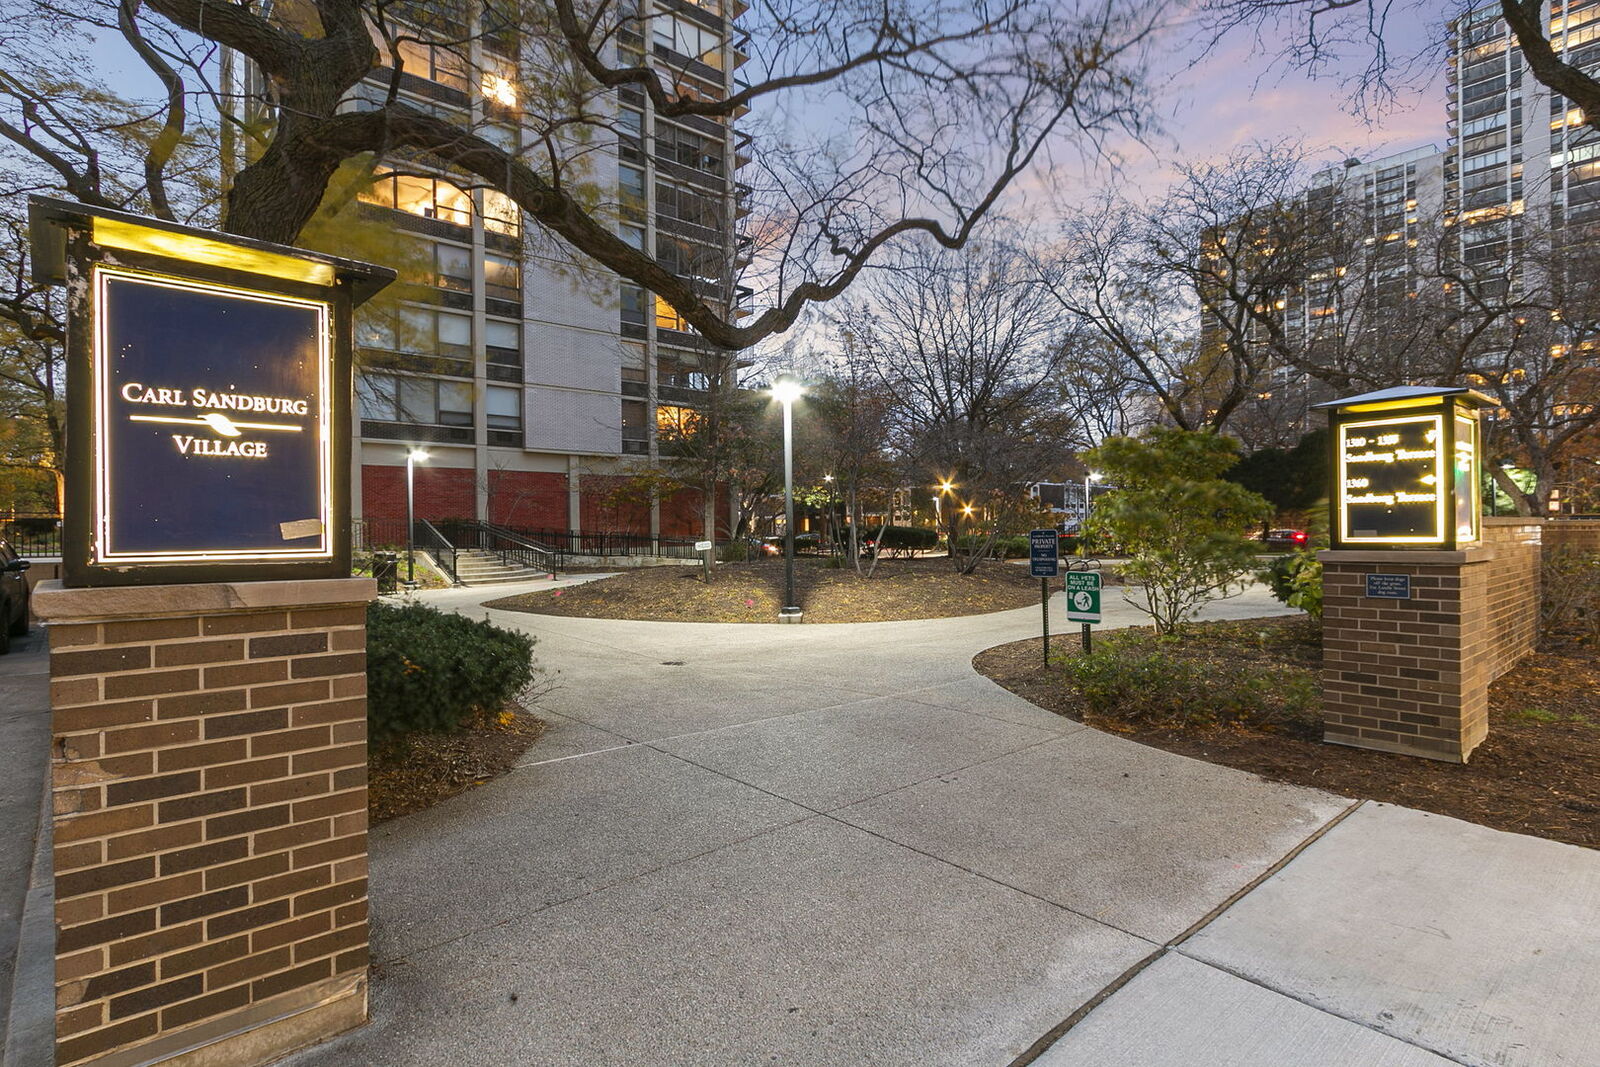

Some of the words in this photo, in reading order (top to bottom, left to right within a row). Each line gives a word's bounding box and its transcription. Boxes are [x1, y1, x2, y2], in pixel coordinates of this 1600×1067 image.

[122, 383, 187, 406] CARL
[192, 389, 308, 415] SANDBURG
[172, 435, 268, 458] VILLAGE
